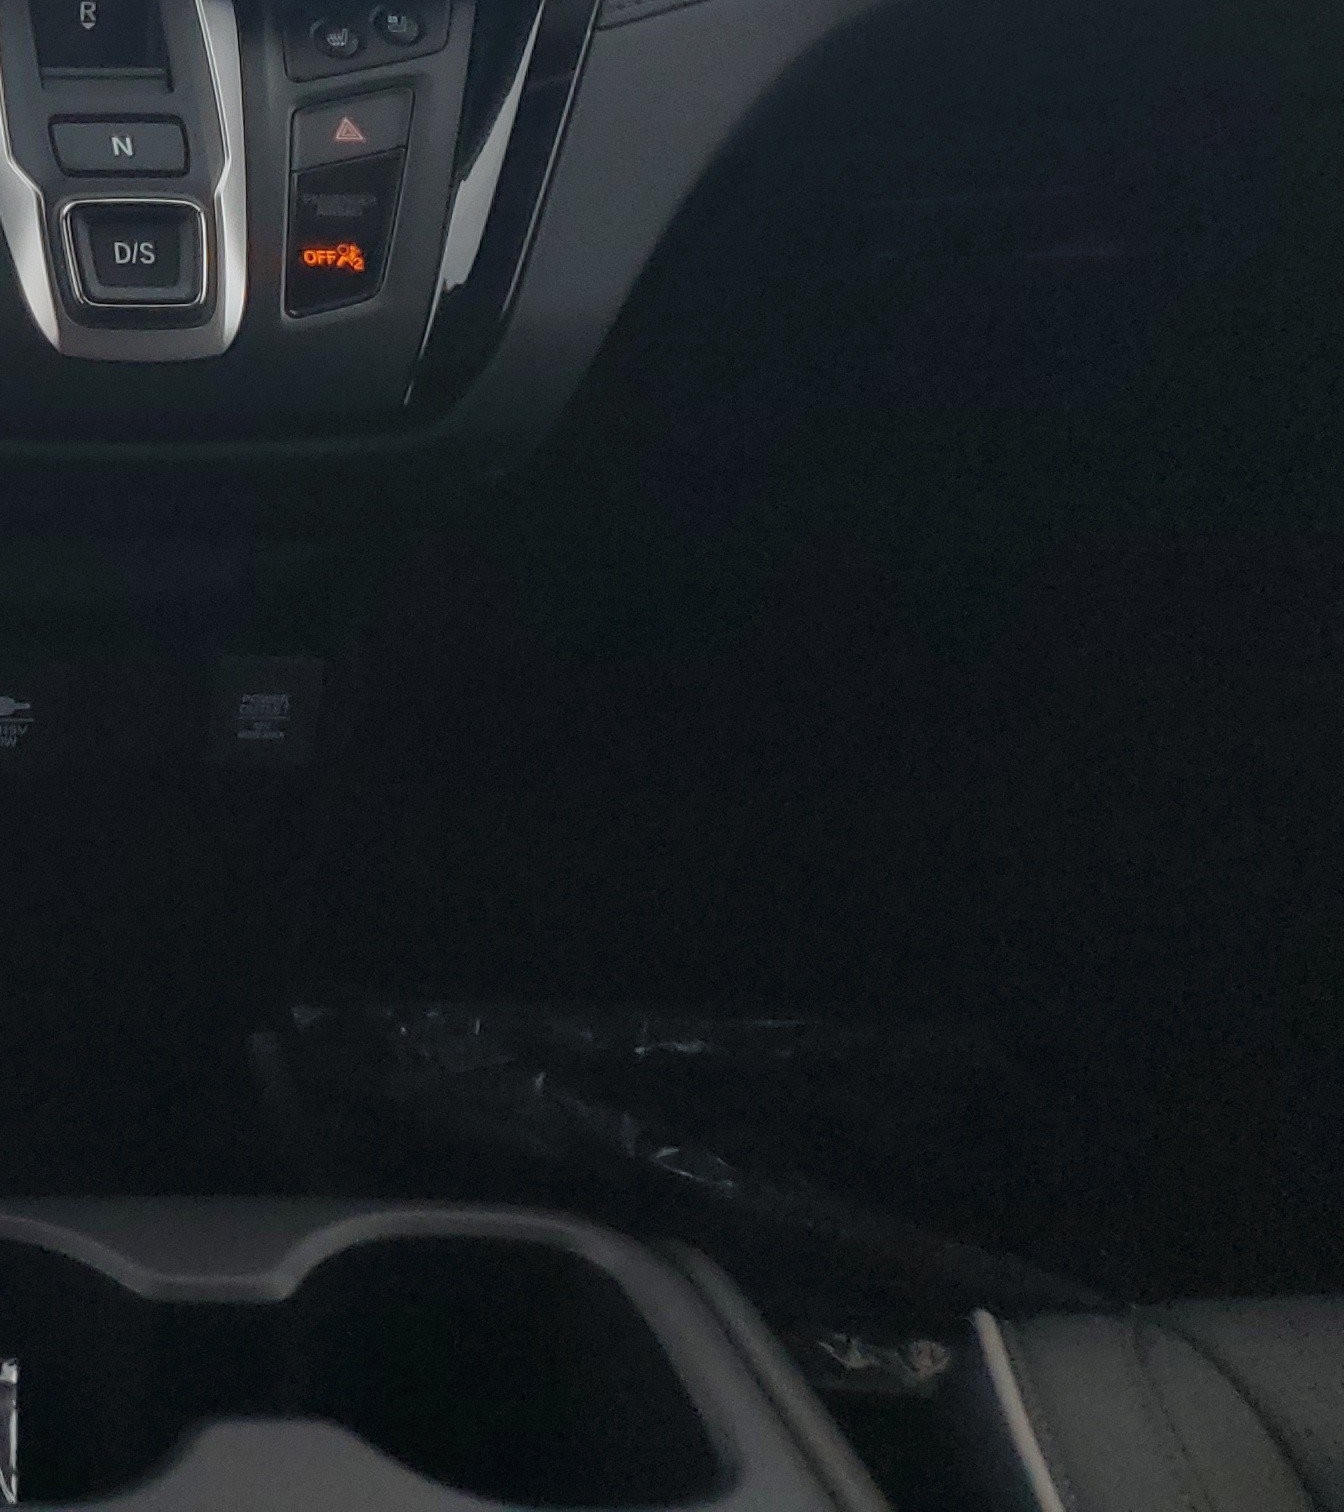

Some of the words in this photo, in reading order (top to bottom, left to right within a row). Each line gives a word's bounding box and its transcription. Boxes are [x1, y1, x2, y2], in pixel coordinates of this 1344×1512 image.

[79, 1, 97, 22] R
[112, 136, 134, 157] N
[113, 241, 156, 265] D/S
[303, 249, 338, 266] OFF
